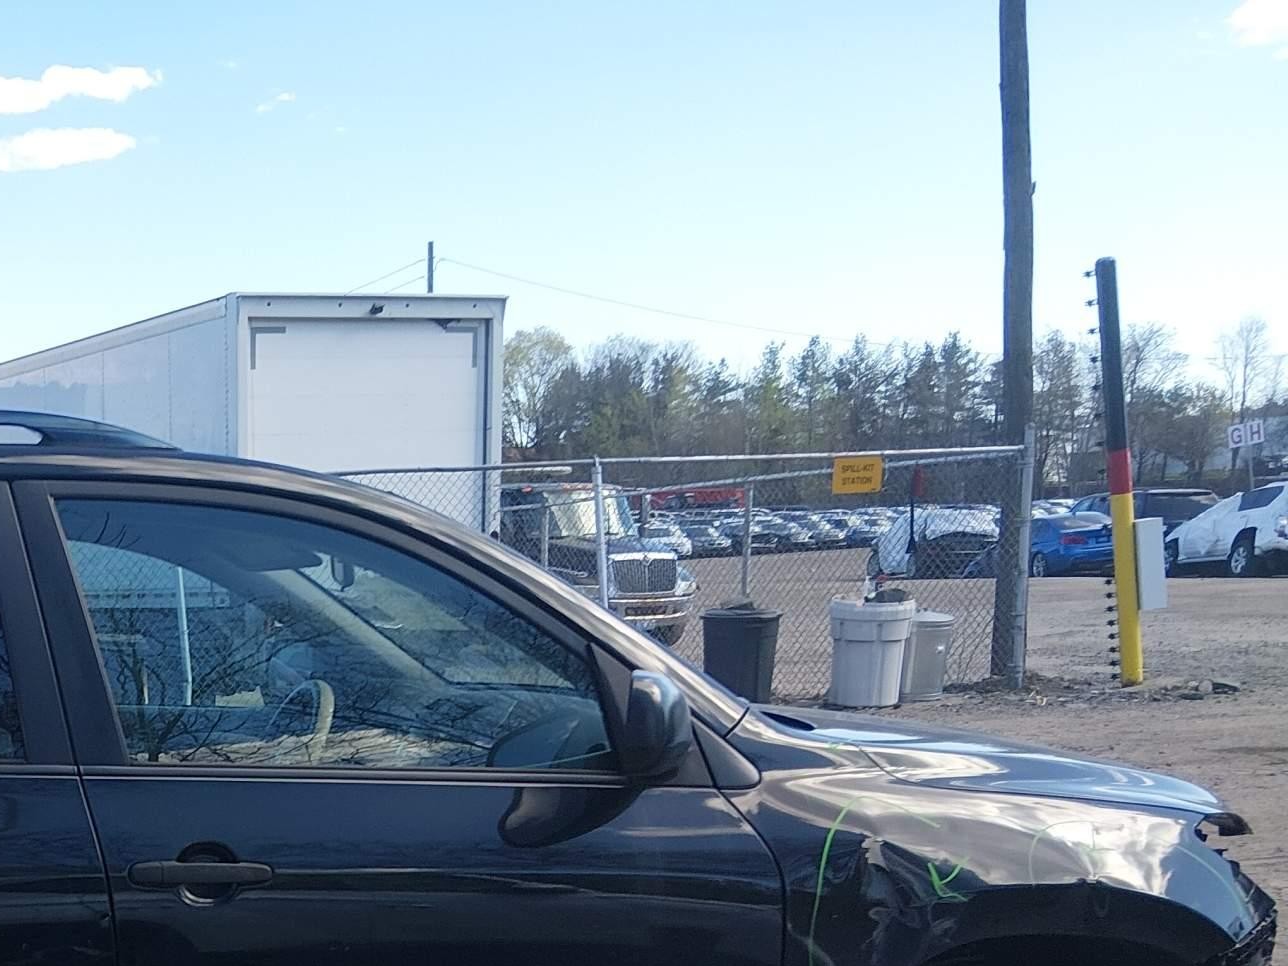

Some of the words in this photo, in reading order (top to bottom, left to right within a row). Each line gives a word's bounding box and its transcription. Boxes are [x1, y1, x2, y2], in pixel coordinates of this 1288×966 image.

[1230, 427, 1243, 445] G
[1249, 422, 1262, 442] H
[841, 476, 873, 486] STATION
